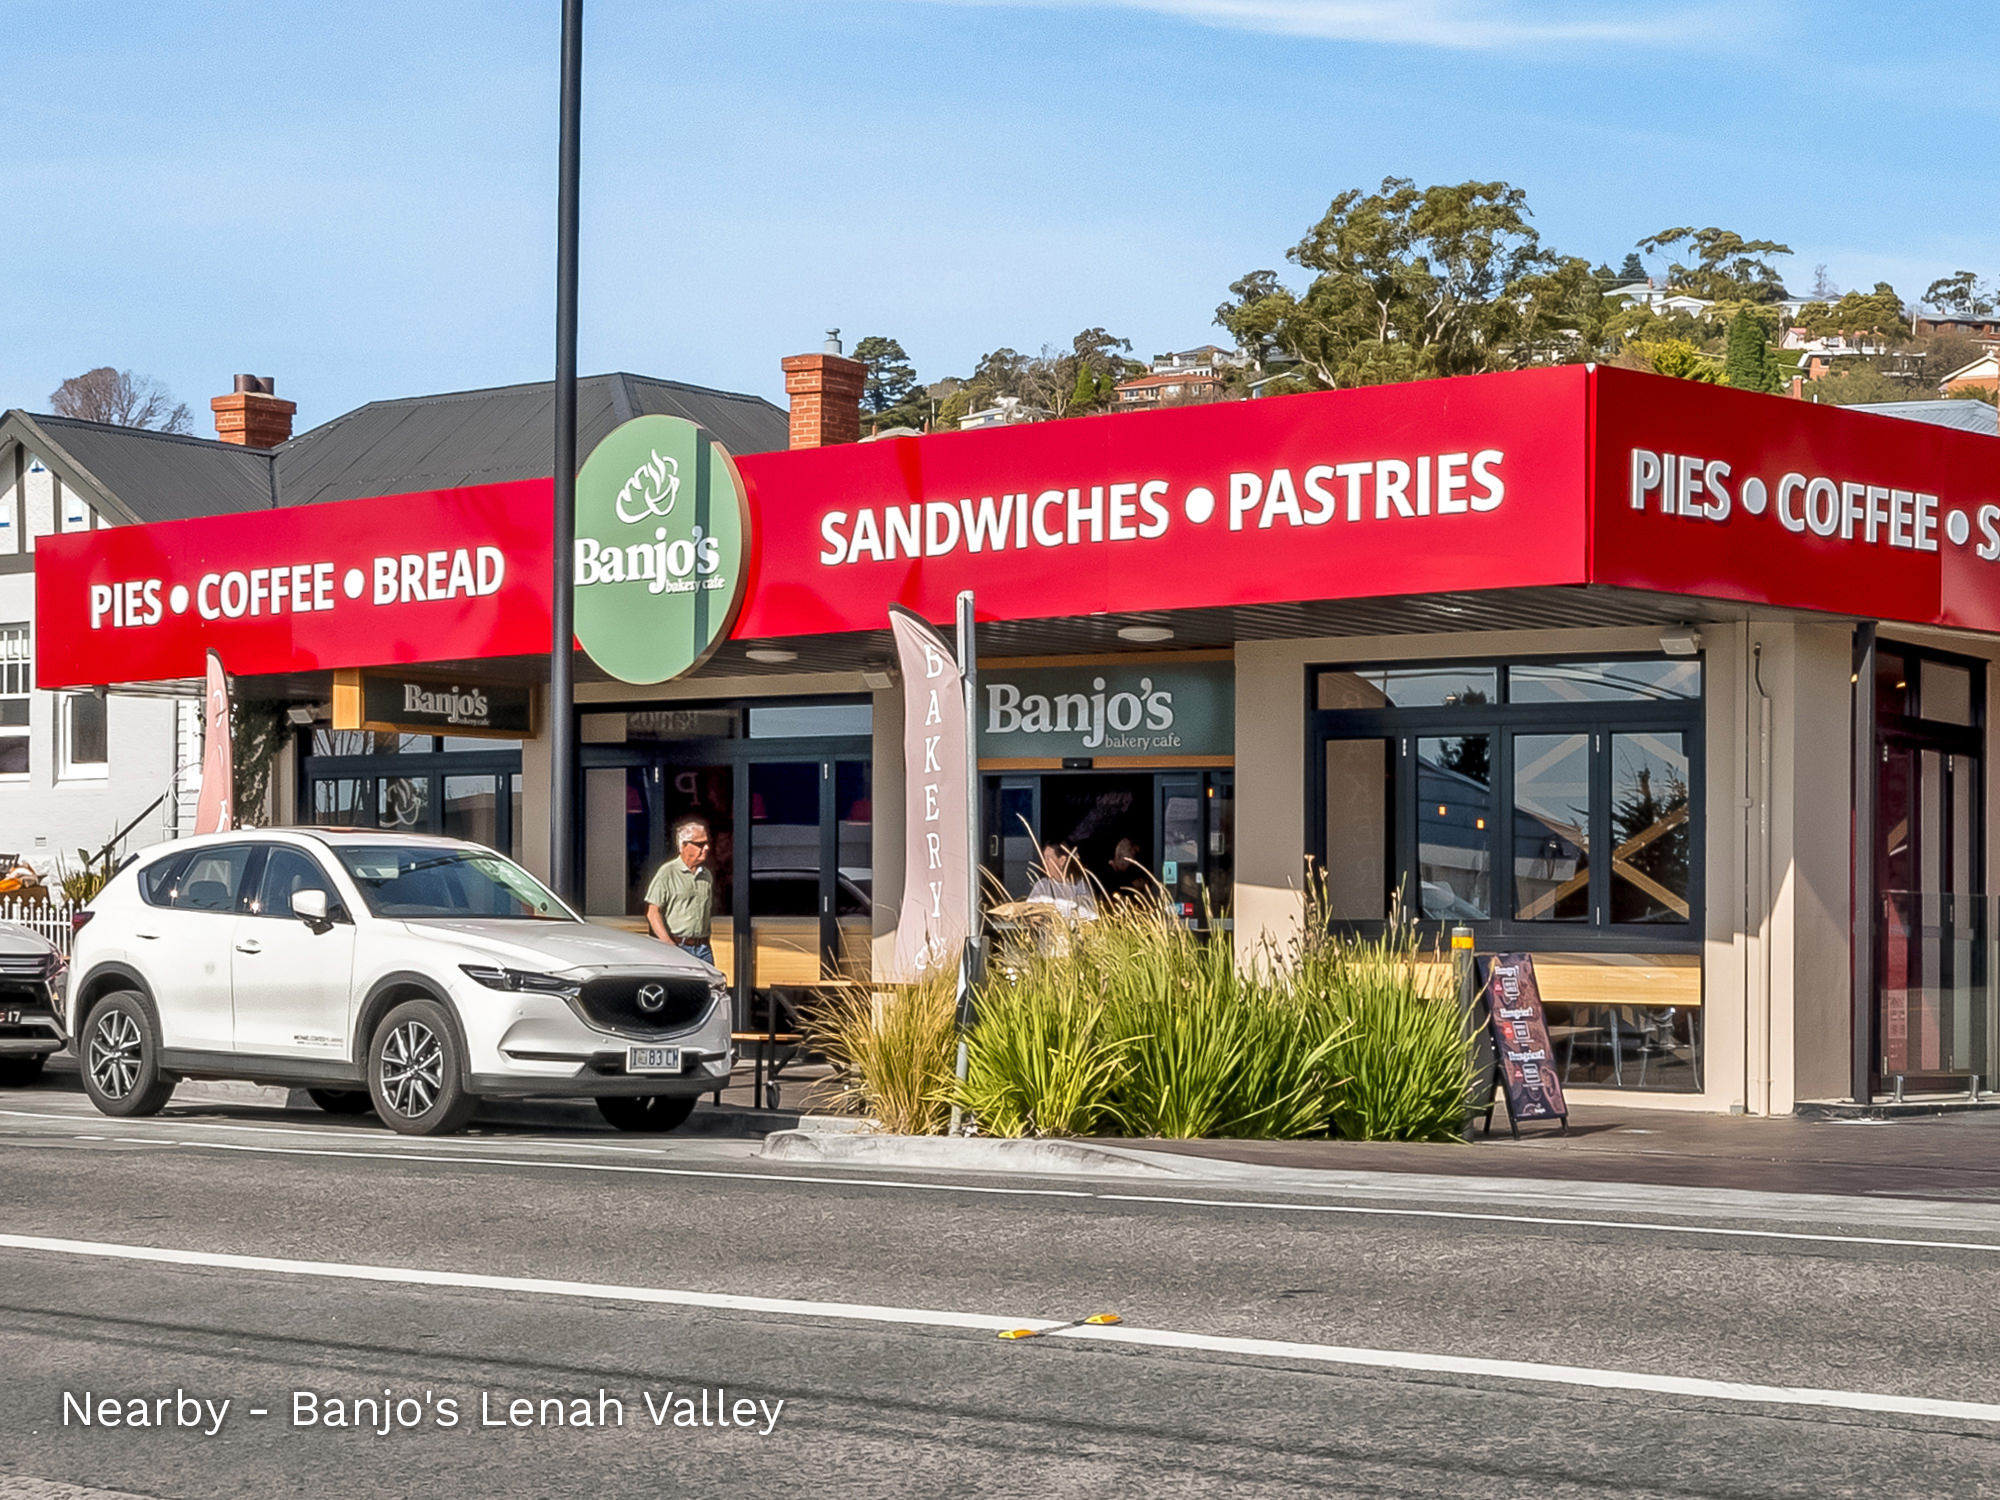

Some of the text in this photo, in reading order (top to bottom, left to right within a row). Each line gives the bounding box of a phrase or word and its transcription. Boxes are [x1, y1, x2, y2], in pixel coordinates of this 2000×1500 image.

[819, 449, 1505, 566] SANDWICHES PASTRIES
[1630, 448, 1732, 522] PIES
[1777, 472, 1939, 551] COFFEE
[91, 546, 504, 629] PIES COFFEE BREAD
[574, 525, 720, 594] Banjo's
[403, 684, 488, 723] Banjo's
[985, 676, 1174, 748] Banjo's
[1105, 732, 1181, 750] bakery cafe
[922, 643, 944, 919] BAKERY
